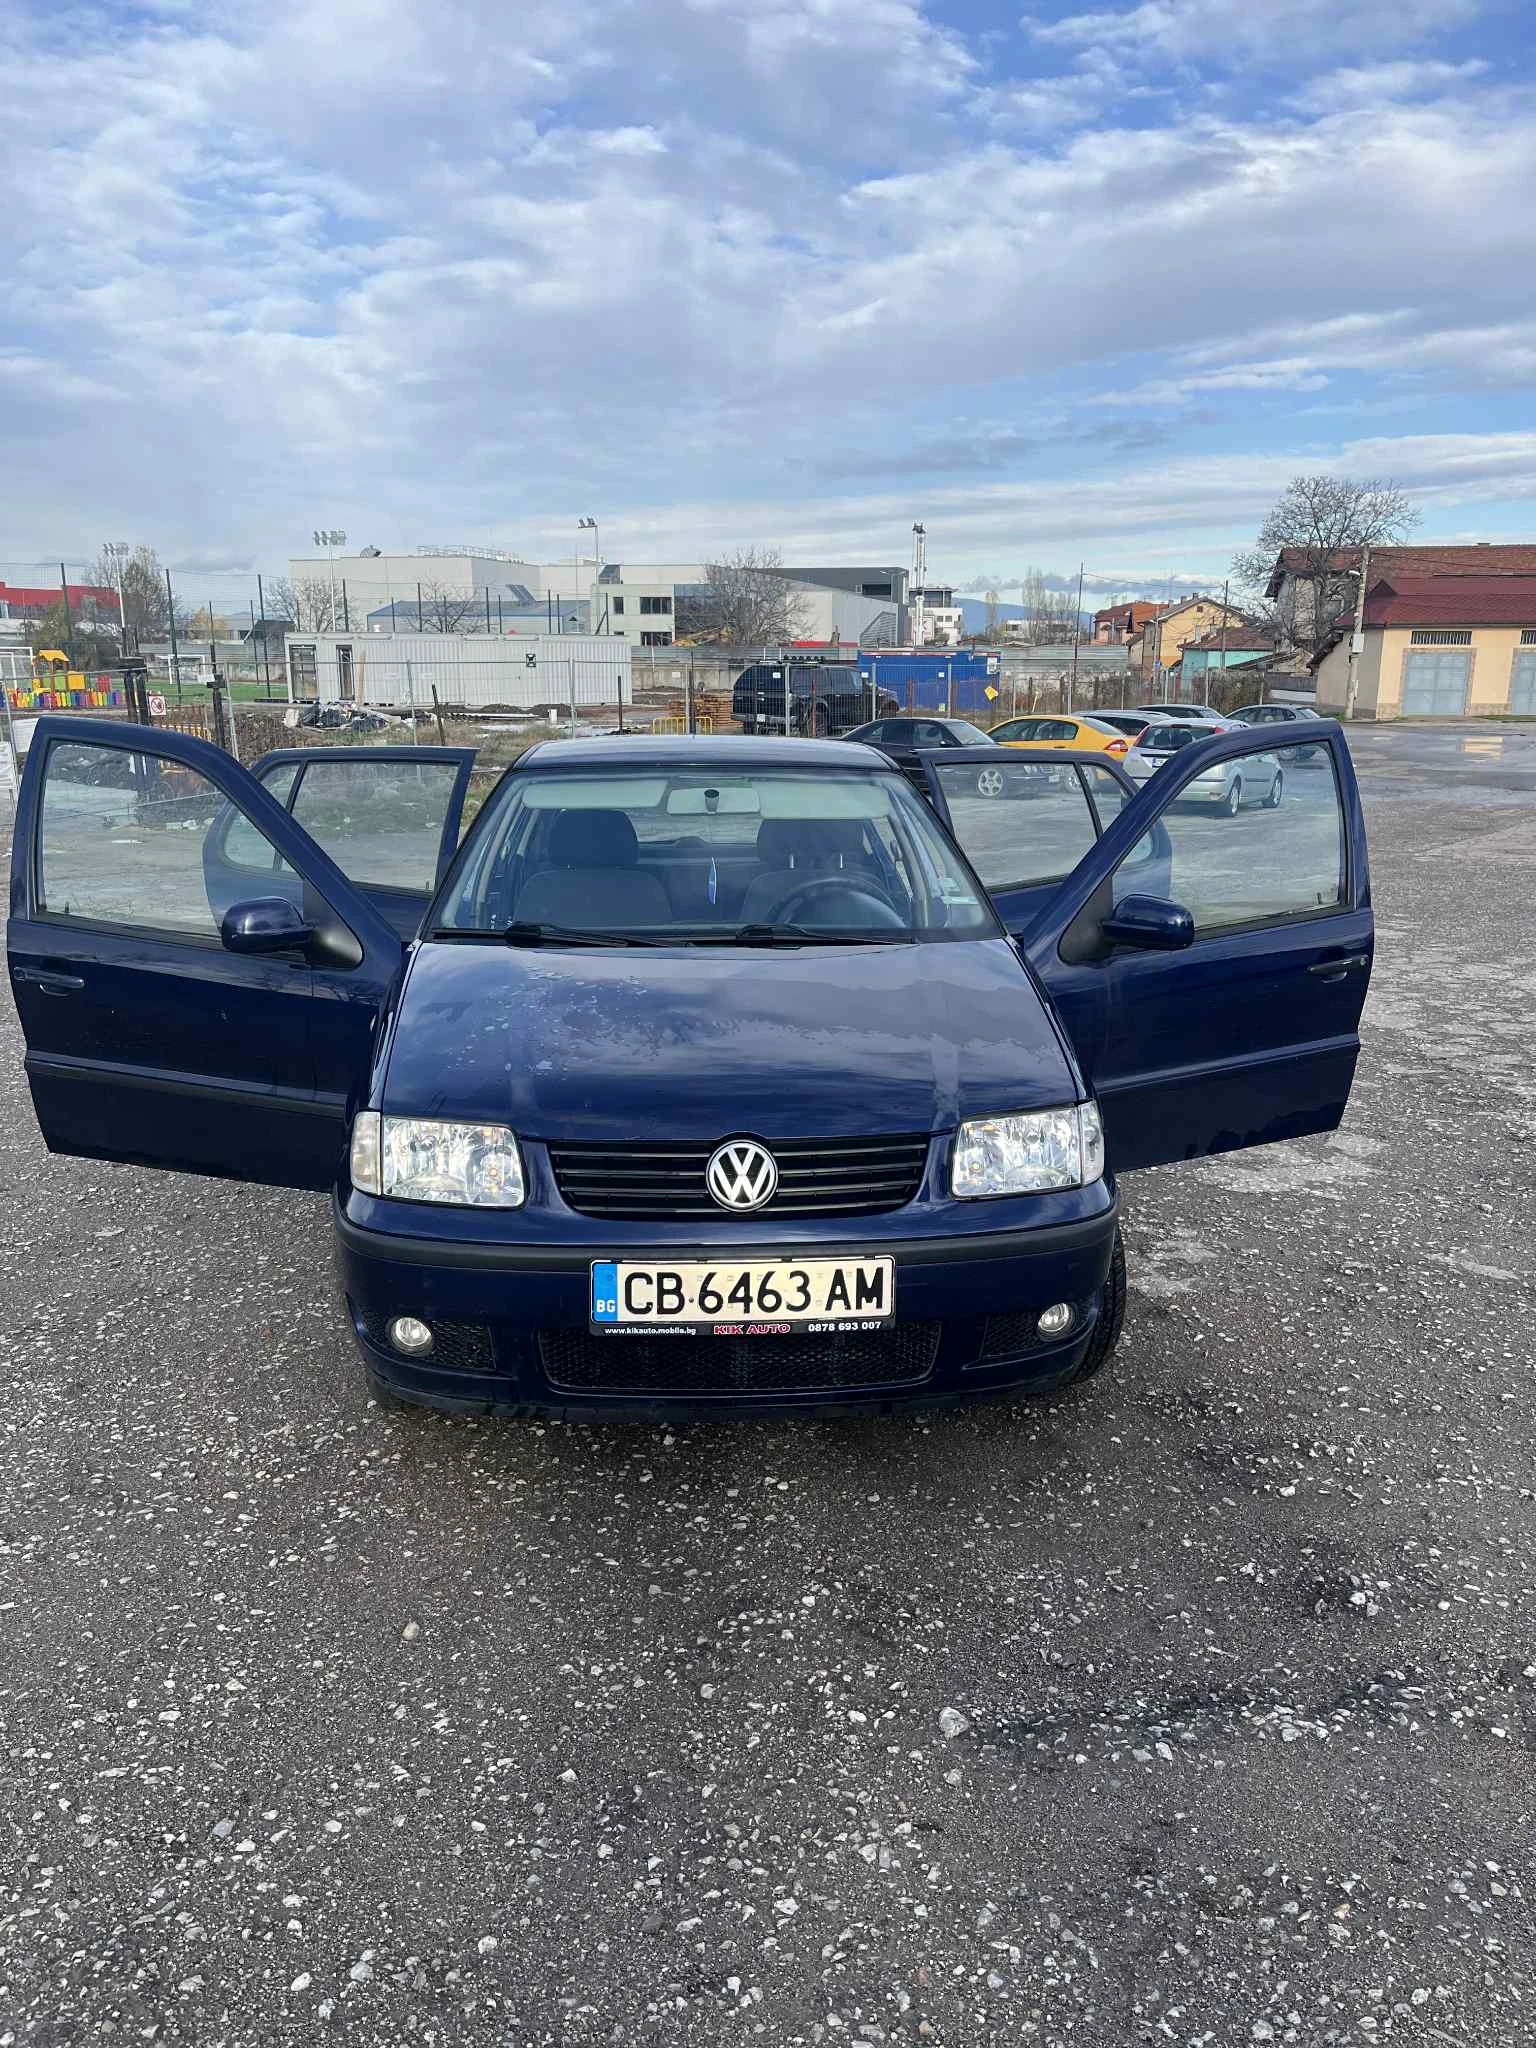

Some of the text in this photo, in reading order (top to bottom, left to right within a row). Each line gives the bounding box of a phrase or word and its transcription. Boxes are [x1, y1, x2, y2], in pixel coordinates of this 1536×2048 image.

[709, 1142, 776, 1208] VW
[624, 1267, 884, 1315] CB 6463 AM
[596, 1300, 616, 1313] BG
[713, 1323, 790, 1335] KIK AUTO
[808, 1321, 881, 1332] 0878 693 007
